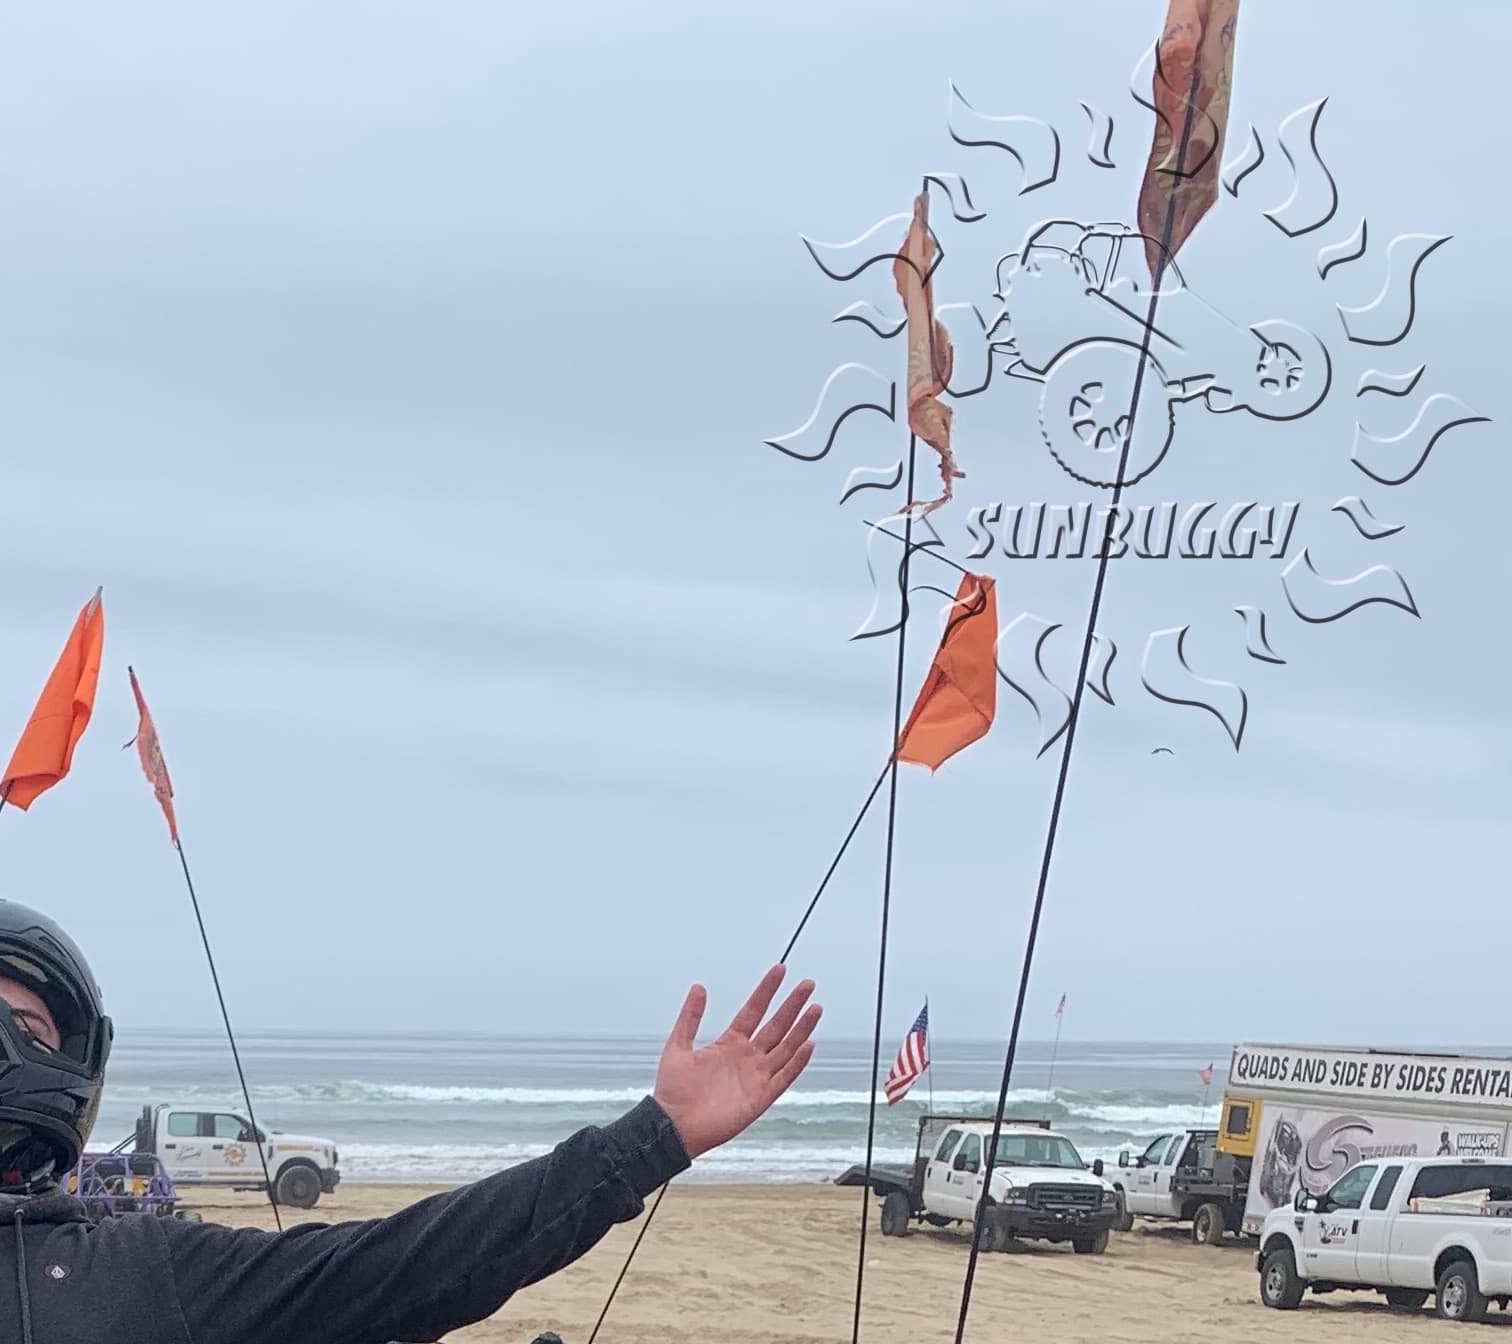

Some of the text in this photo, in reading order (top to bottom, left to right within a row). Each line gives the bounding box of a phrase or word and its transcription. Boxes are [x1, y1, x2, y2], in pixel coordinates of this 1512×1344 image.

[1238, 1053, 1512, 1099] QUADS AND SIDE BY SIDES RENTA
